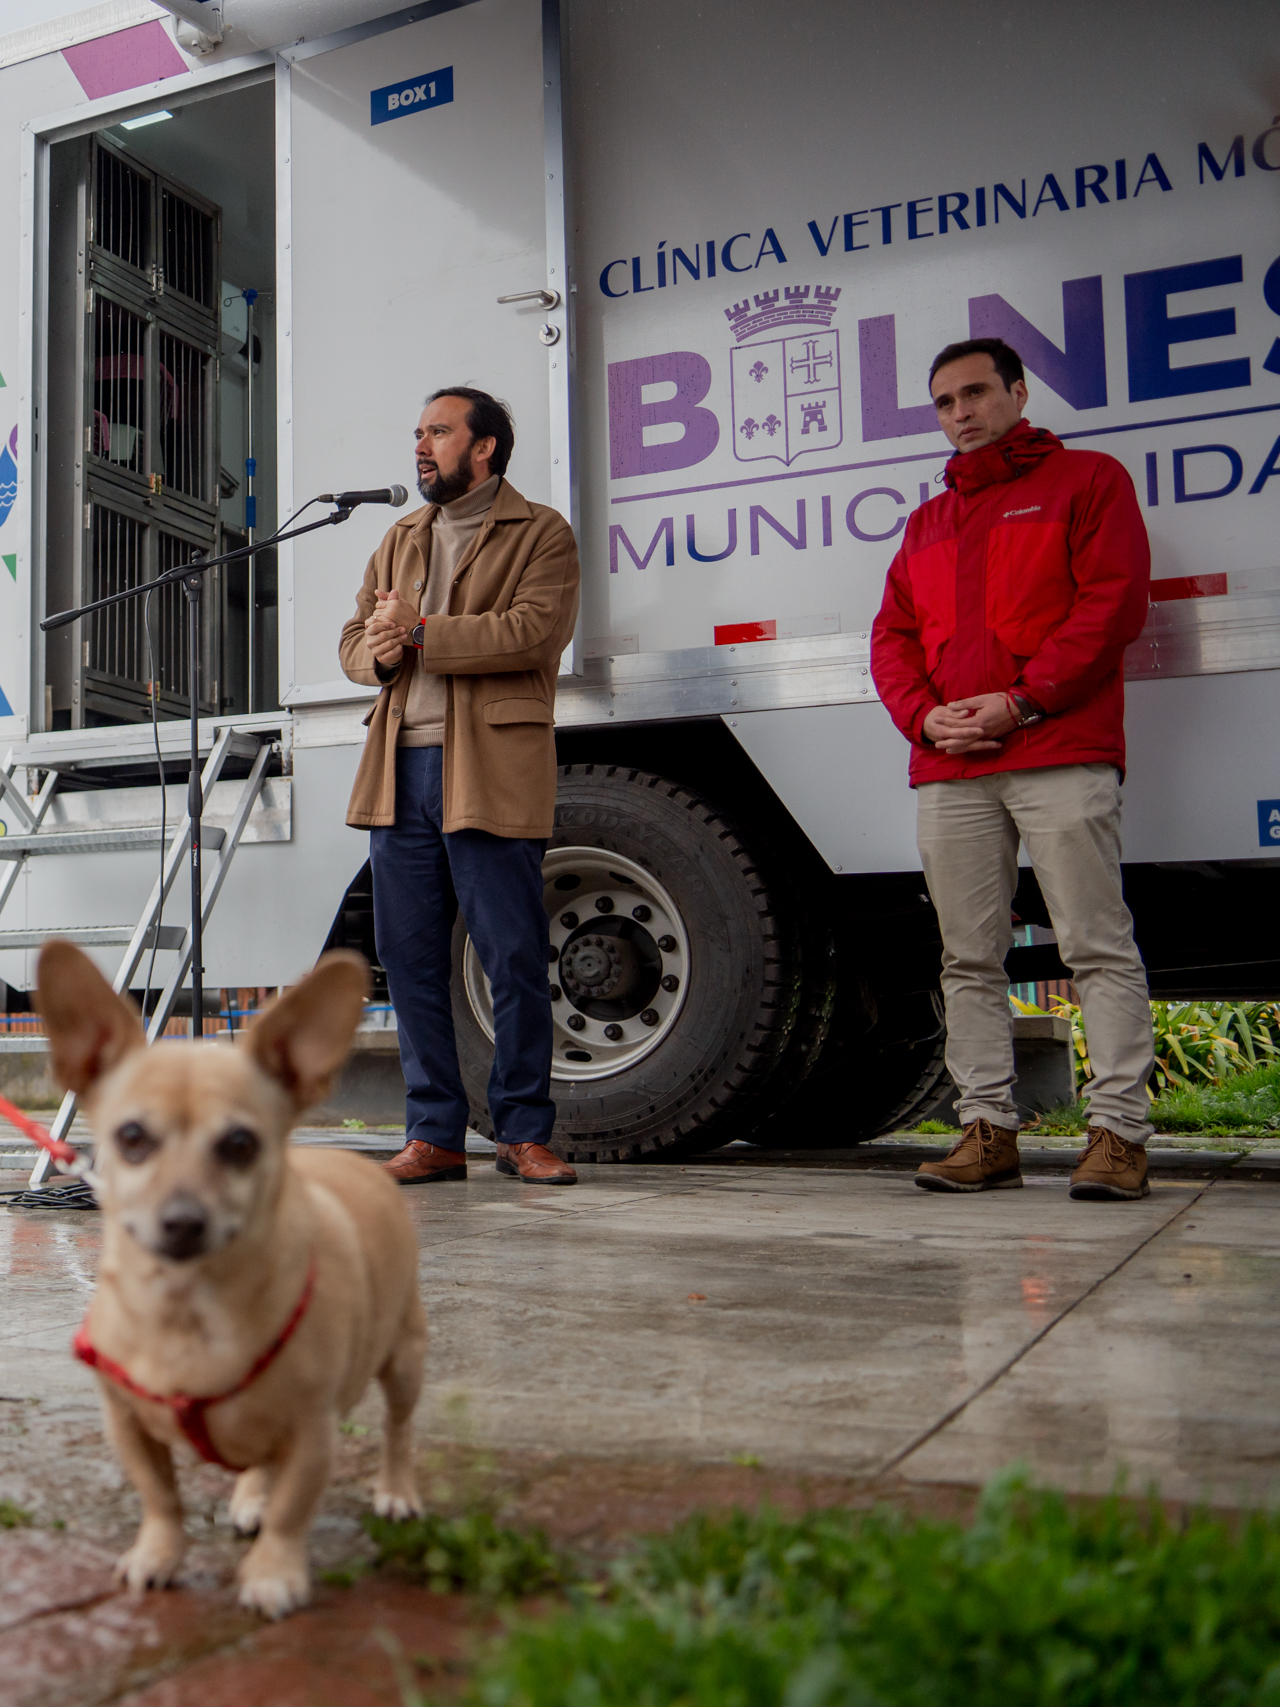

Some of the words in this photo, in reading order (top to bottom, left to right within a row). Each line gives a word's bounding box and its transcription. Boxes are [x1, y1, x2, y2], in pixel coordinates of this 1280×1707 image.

[598, 228, 788, 298] CLÍNICA
[808, 152, 1174, 257] VETERINARIA
[556, 806, 707, 896] OODYEAR
